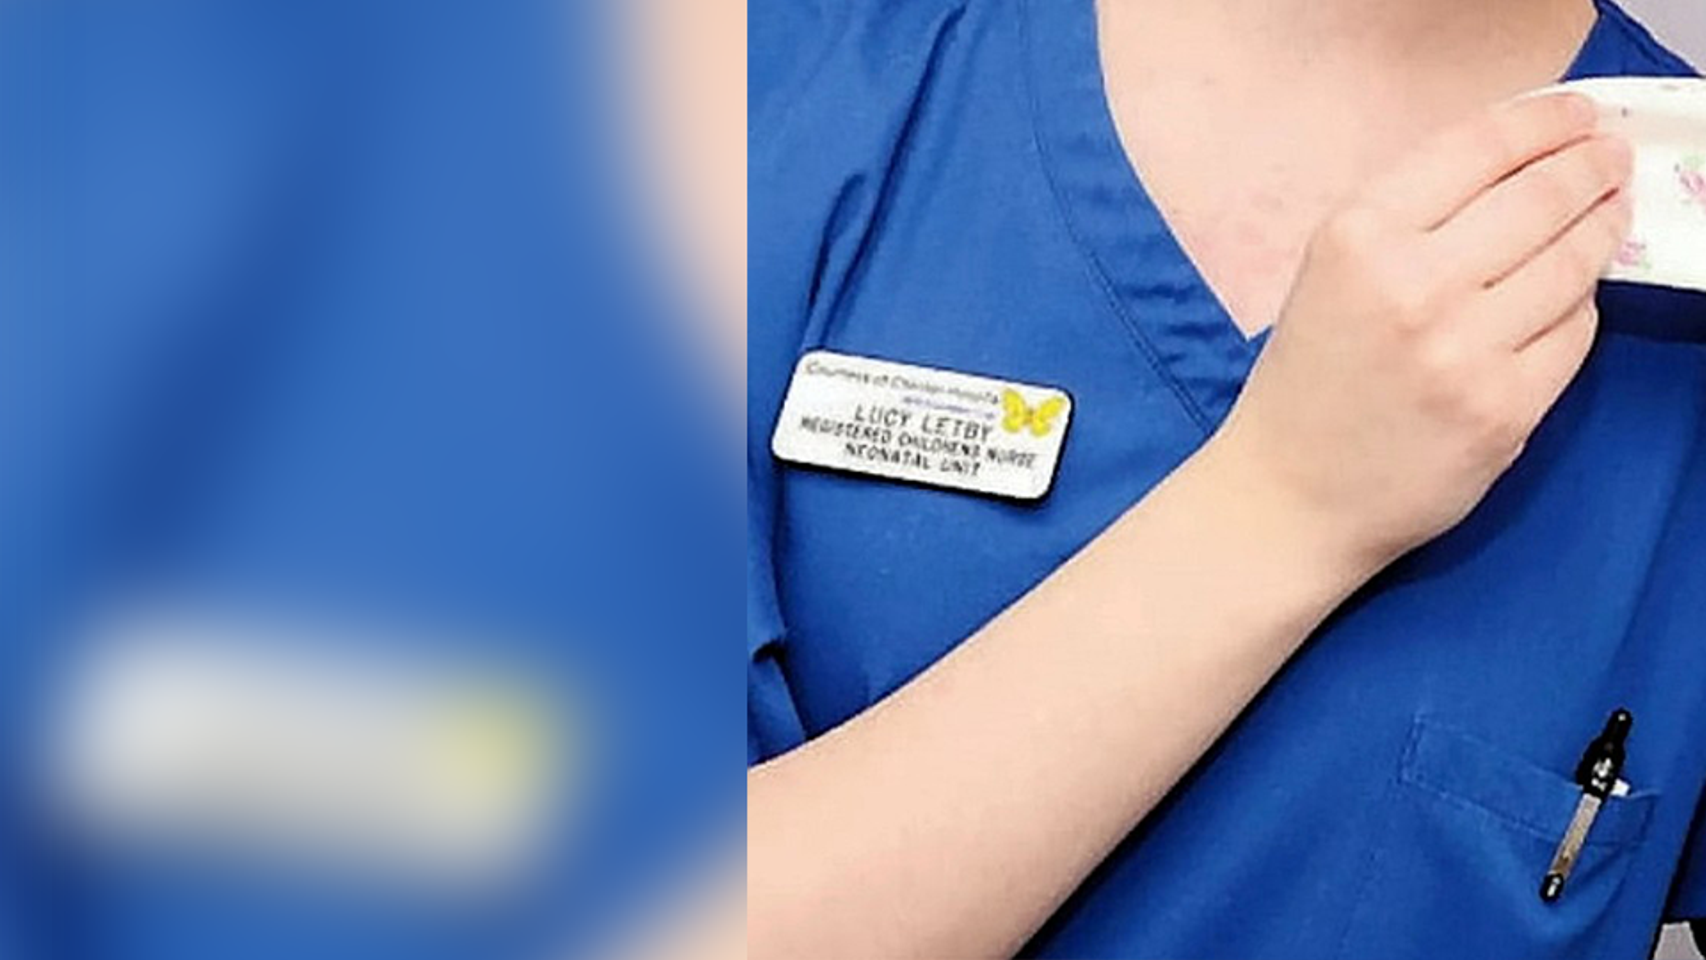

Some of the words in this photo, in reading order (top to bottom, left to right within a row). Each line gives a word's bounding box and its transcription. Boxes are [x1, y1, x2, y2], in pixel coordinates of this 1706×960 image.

[854, 404, 912, 428] LUCY
[921, 415, 993, 442] LETBY
[801, 416, 892, 445] REGISTERED
[987, 448, 1037, 469] NURSE
[844, 442, 931, 470] NEONATAL
[940, 457, 982, 477] UNIT
